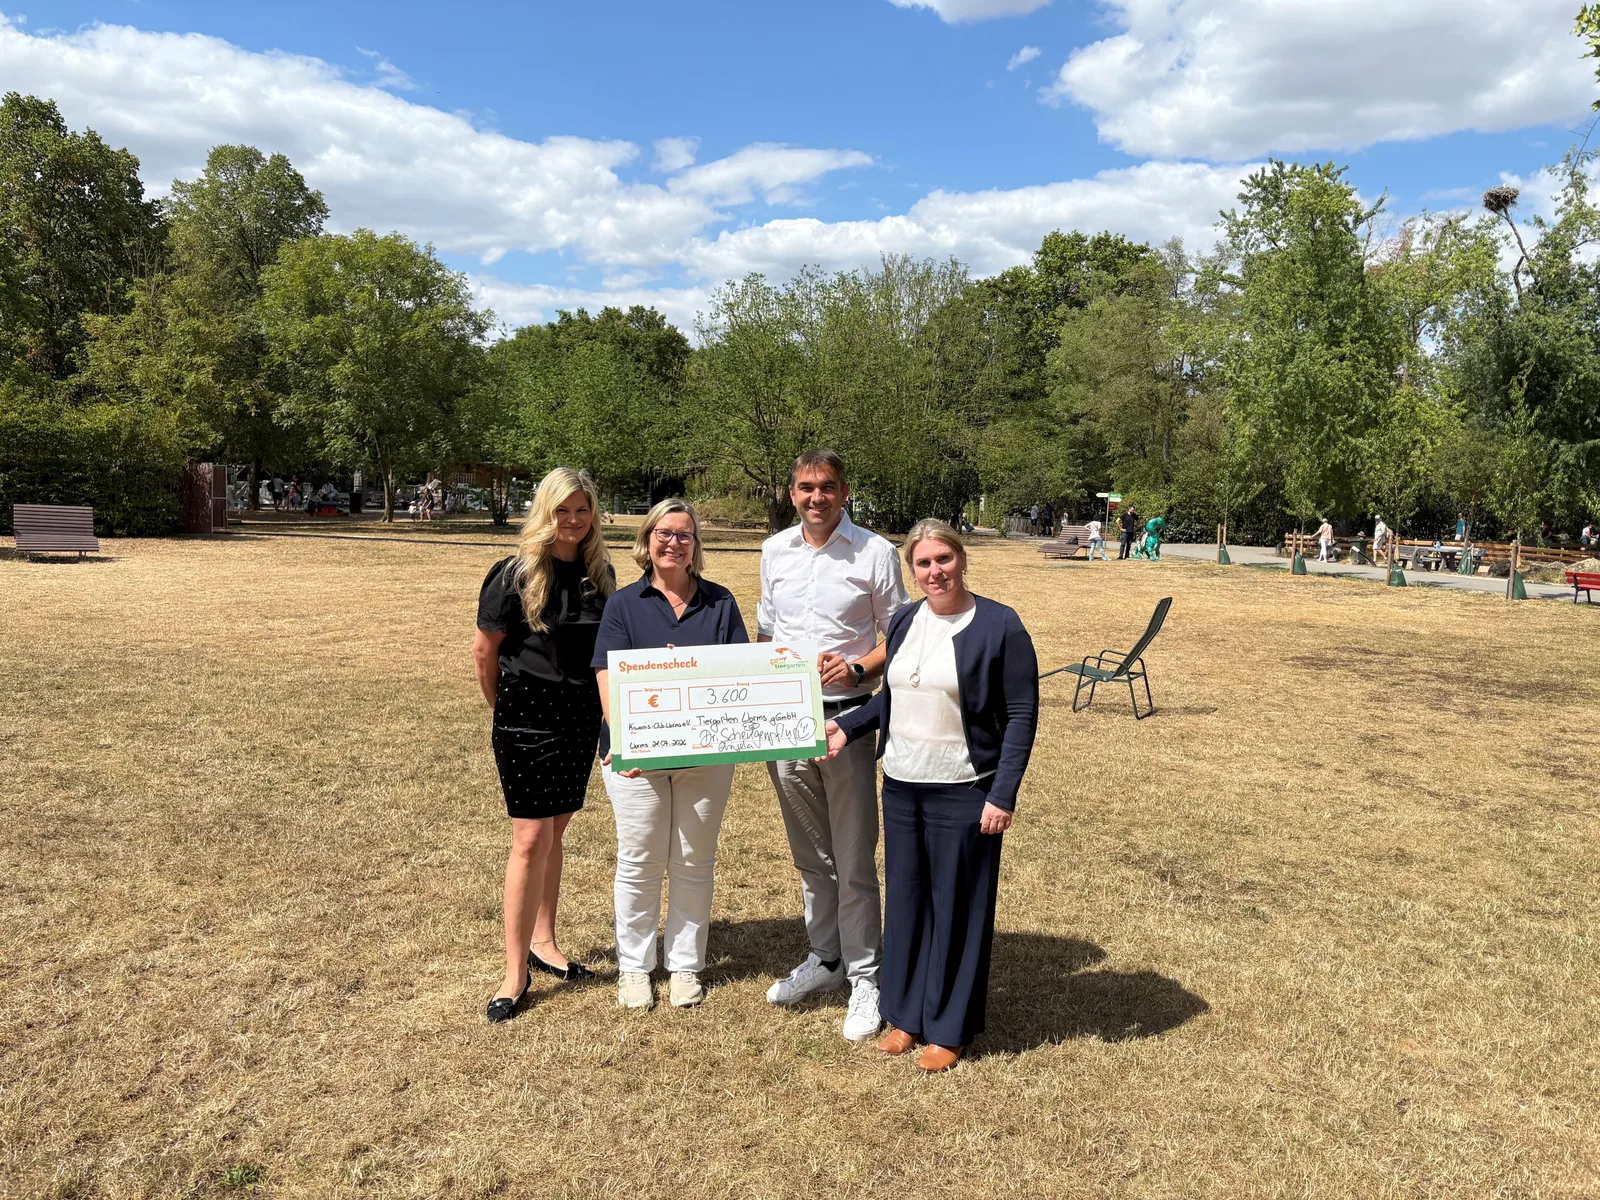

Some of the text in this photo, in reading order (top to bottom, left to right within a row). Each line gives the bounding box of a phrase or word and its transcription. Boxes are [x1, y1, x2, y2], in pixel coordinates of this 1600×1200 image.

[619, 656, 698, 674] Spendenscheck
[774, 662, 806, 670] tiergarten
[647, 694, 659, 708] €
[706, 687, 748, 705] 3.600
[696, 712, 739, 733] Tiergarten
[741, 711, 767, 723] Worms
[768, 711, 797, 726] gGmbH
